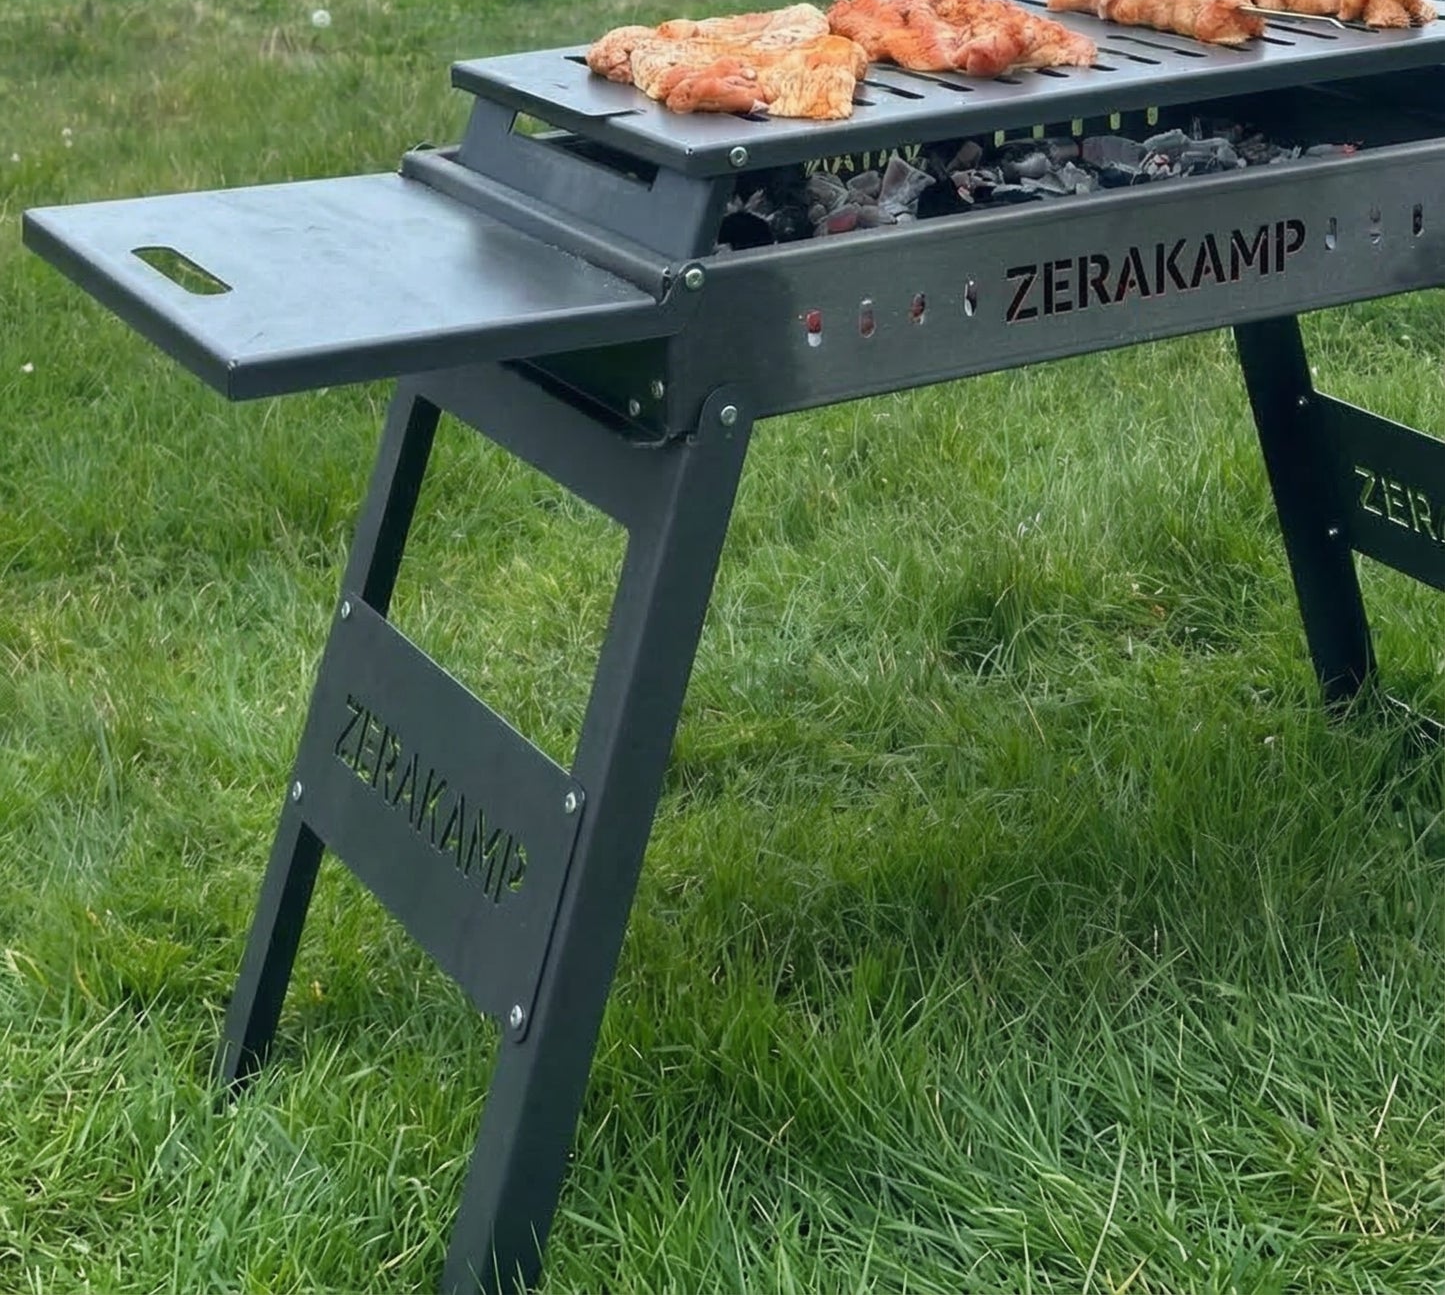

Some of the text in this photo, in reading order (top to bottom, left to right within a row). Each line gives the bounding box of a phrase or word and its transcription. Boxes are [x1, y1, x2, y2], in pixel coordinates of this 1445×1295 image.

[1006, 218, 1307, 323] ZERAKAMP
[1354, 466, 1445, 544] ZER
[333, 693, 527, 904] ZERAKAMP
